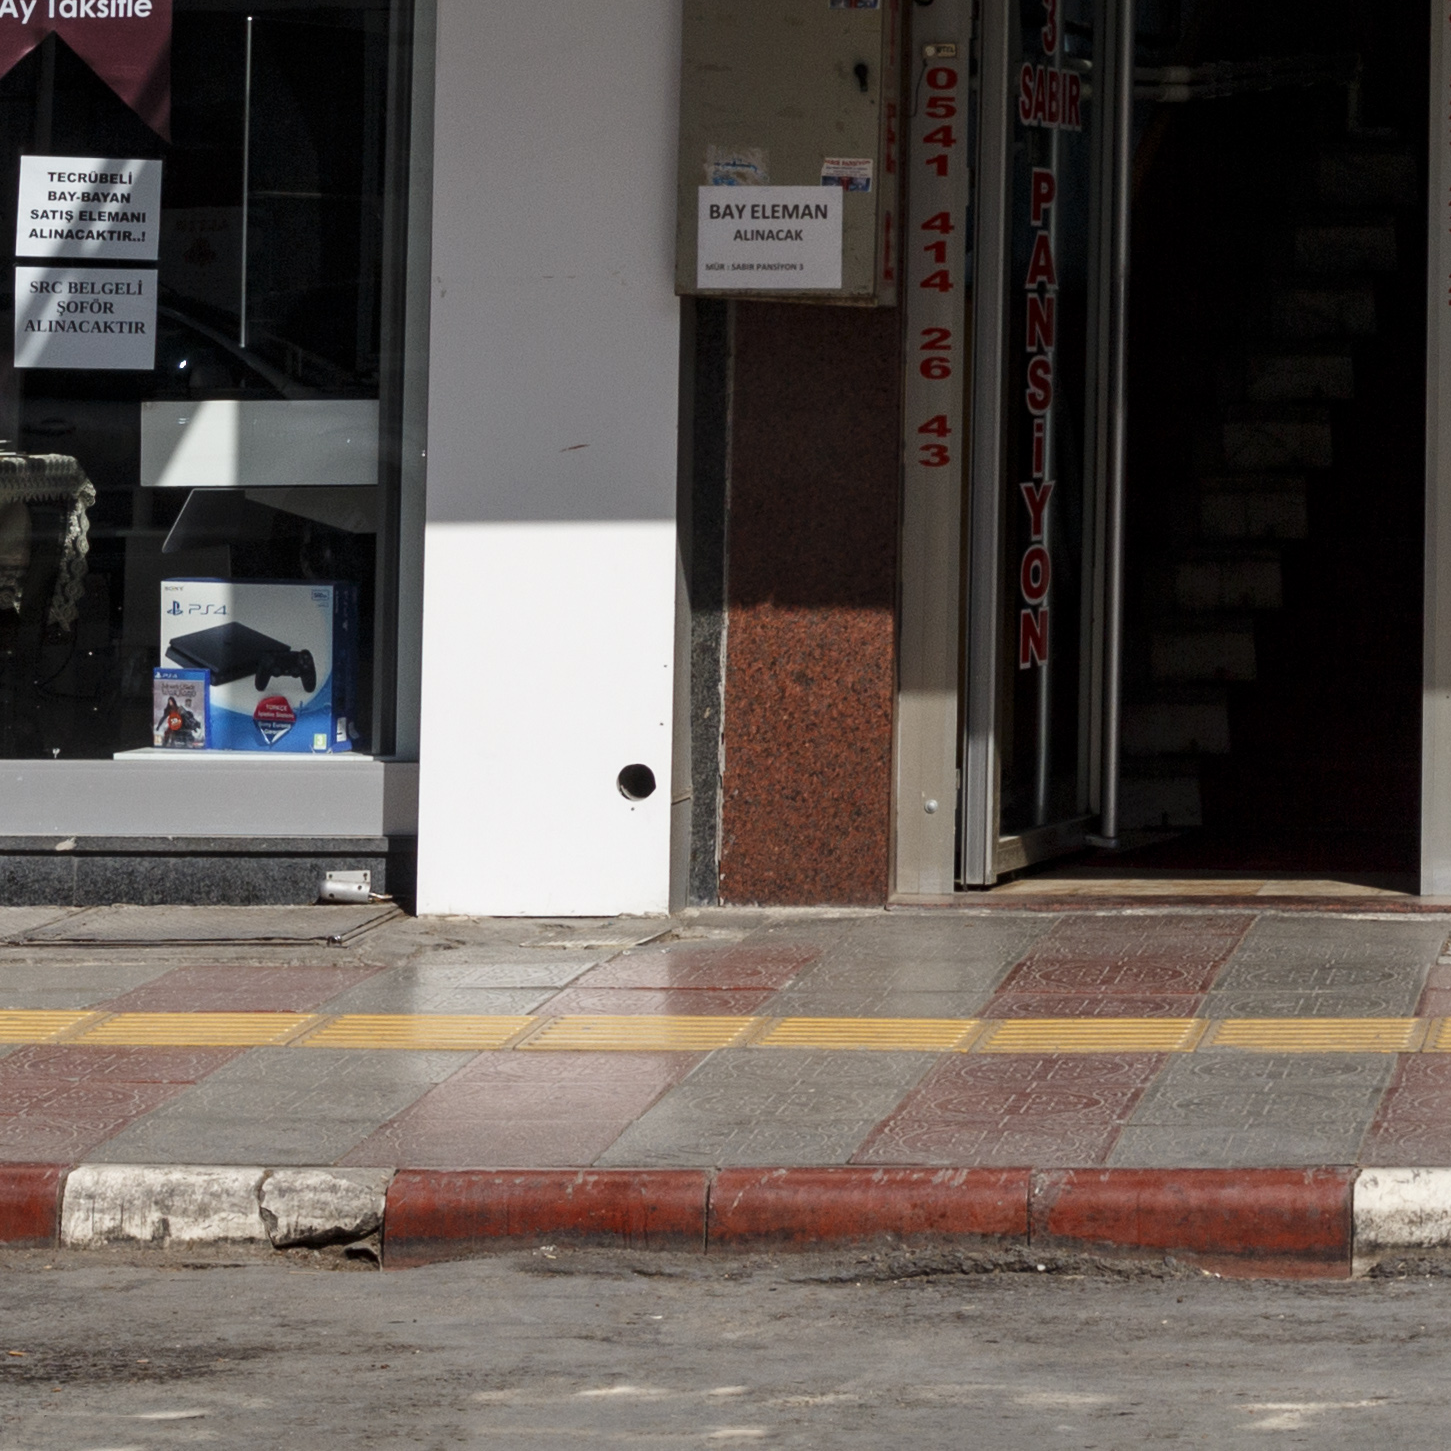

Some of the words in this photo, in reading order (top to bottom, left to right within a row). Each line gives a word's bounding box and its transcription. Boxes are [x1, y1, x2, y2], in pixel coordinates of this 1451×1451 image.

[1018, 62, 1082, 132] SABIR
[922, 67, 958, 177] 0541
[48, 170, 133, 185] TECRÜBELİ
[47, 191, 131, 204] BAY-BAYAN
[30, 209, 74, 223] SATIŞ
[79, 210, 146, 223] ELEMANI
[709, 204, 746, 220] BAY
[751, 204, 828, 220] ELEMAN
[29, 228, 146, 243] ALINACAKTIR..!
[733, 229, 803, 241] ALINACAK
[919, 211, 955, 293] 414
[30, 281, 63, 294] SRC
[68, 279, 143, 295] BELGELİ
[56, 299, 115, 316] ŞOFÖR
[24, 319, 146, 335] ALINACAKTIR
[919, 327, 953, 380] 26
[917, 415, 952, 467] 43
[188, 603, 228, 615] PS4
